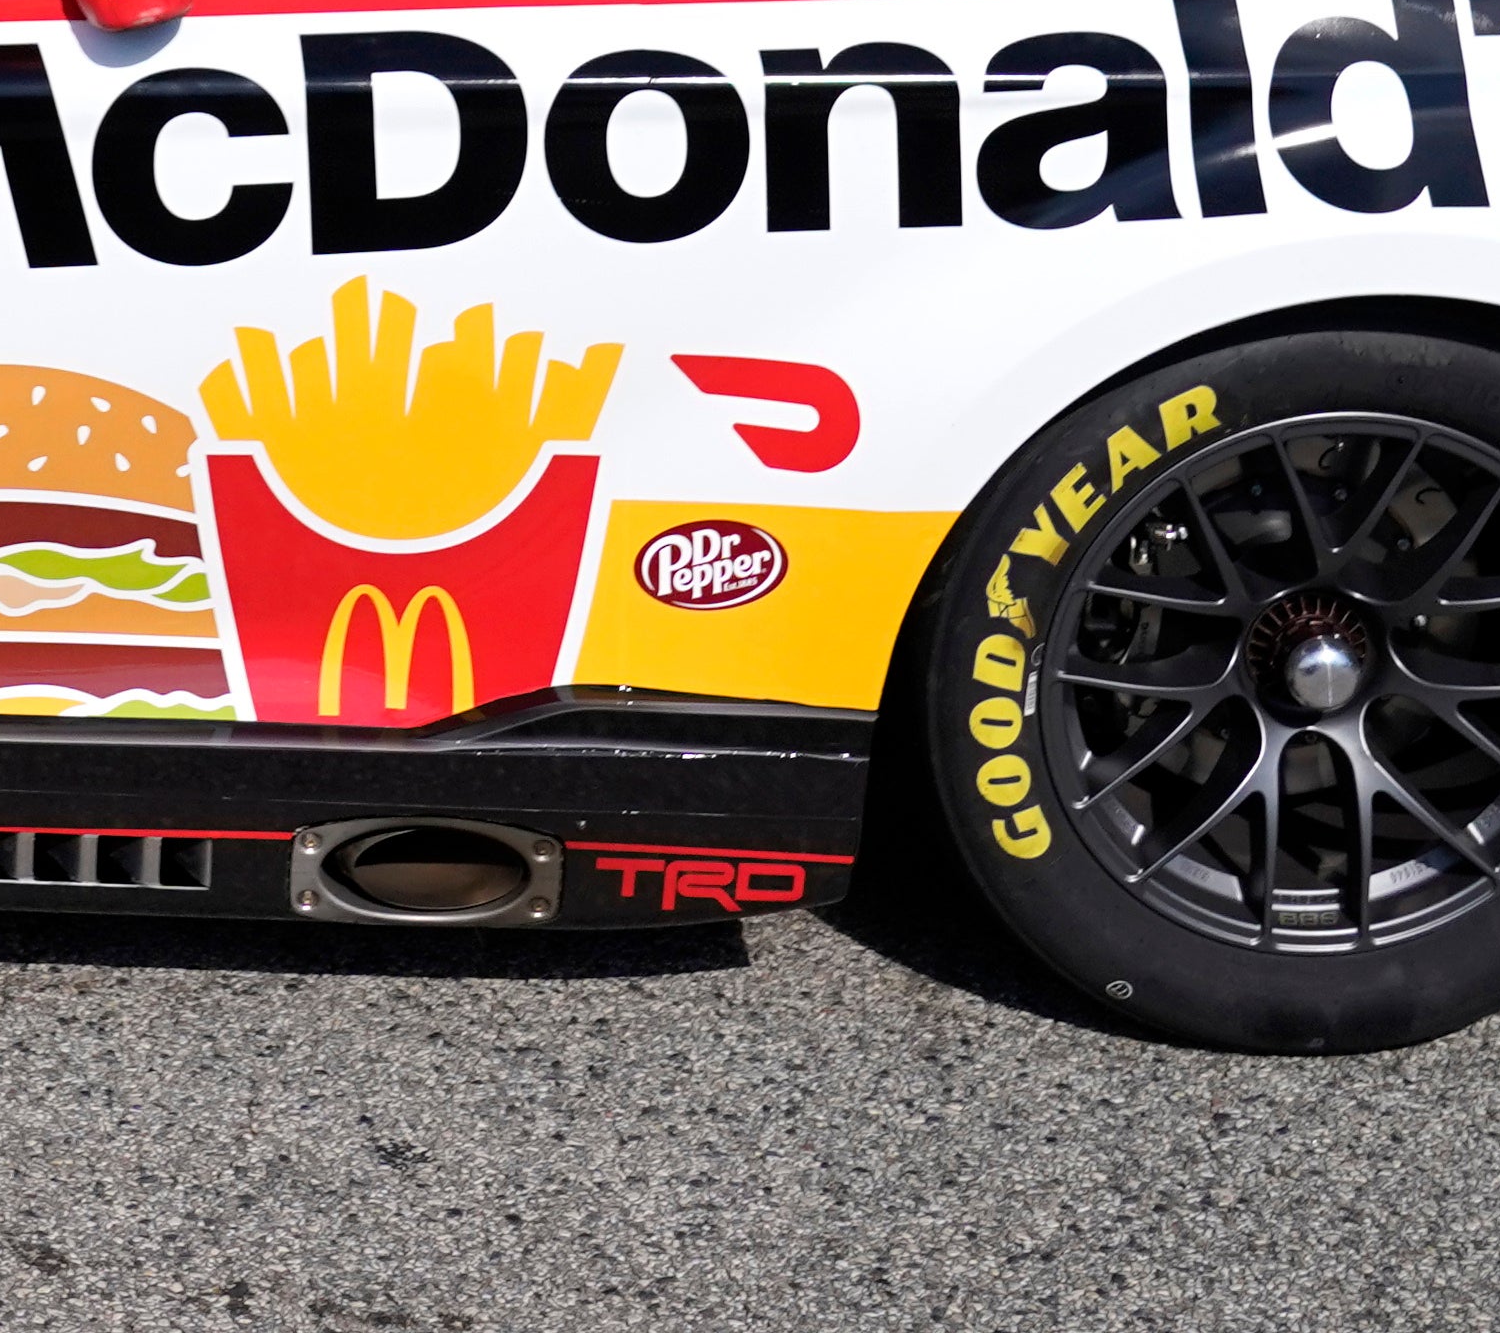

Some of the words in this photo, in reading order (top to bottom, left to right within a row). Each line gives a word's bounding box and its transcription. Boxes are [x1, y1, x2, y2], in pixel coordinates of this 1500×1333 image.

[641, 533, 772, 600] Pepper
[691, 528, 742, 566] Dr
[968, 384, 1222, 860] GOODYEAR
[595, 854, 806, 912] TRD
